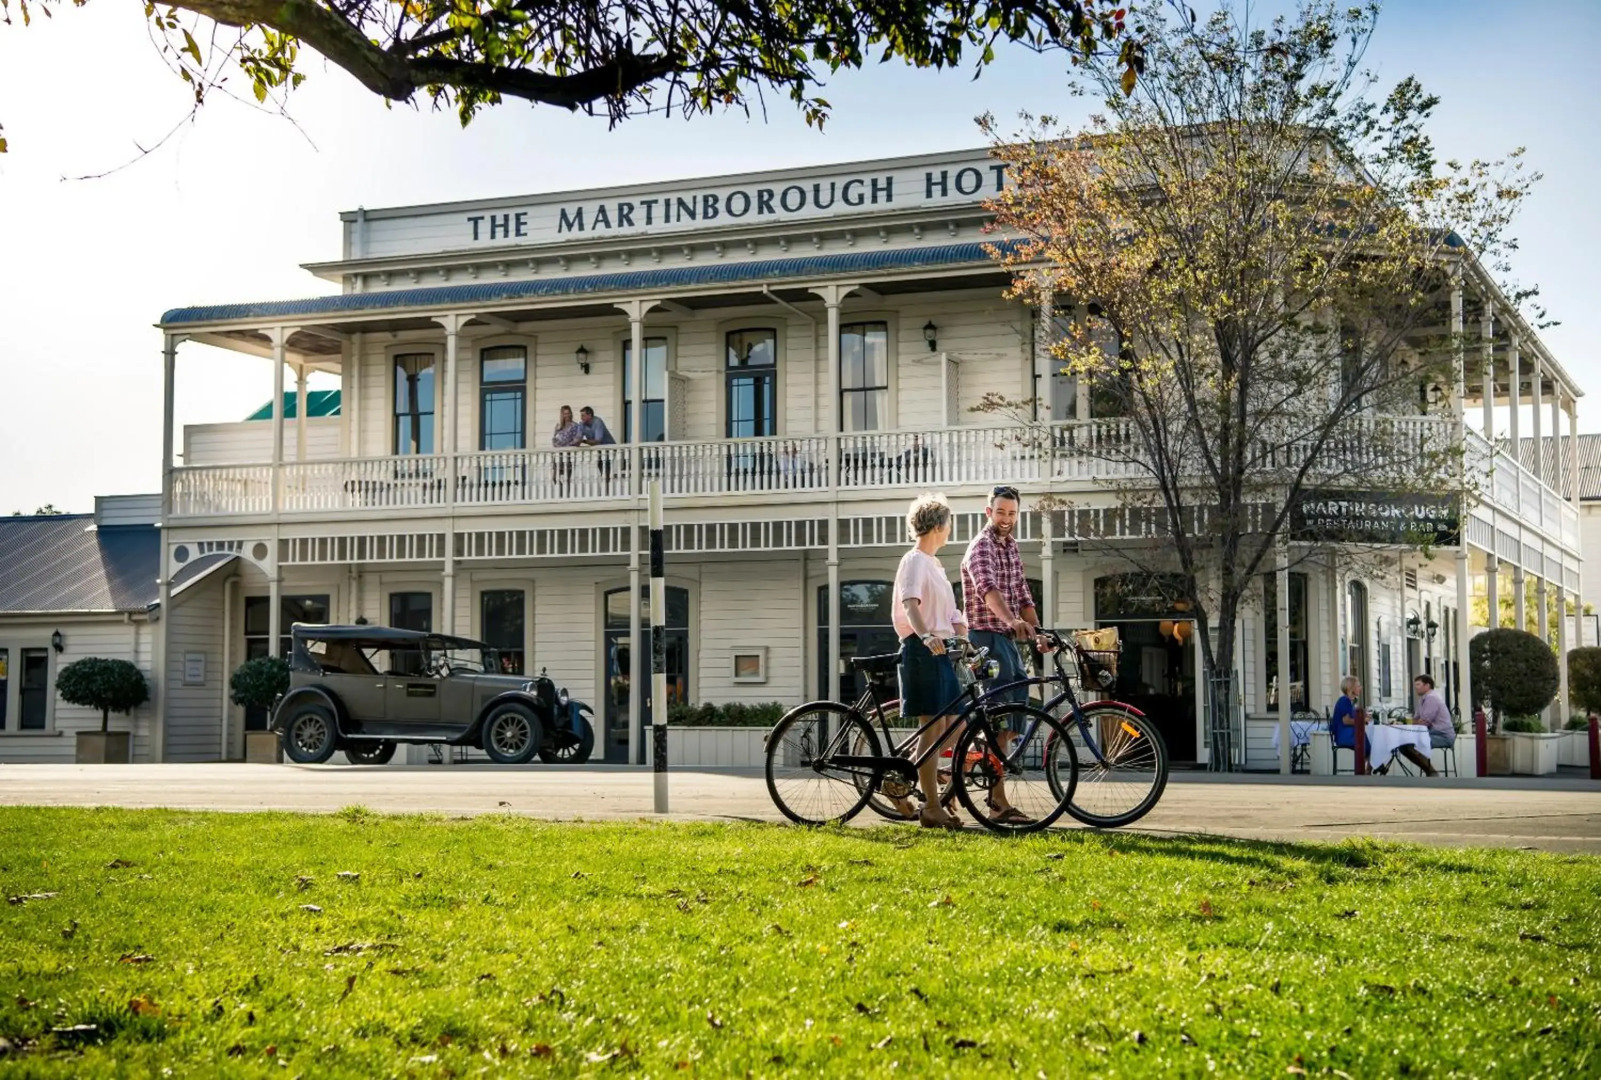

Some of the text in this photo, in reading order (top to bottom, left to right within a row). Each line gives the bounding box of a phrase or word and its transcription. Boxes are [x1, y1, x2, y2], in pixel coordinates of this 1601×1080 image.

[467, 162, 1024, 241] THE MARTINBOROUGH HOT
